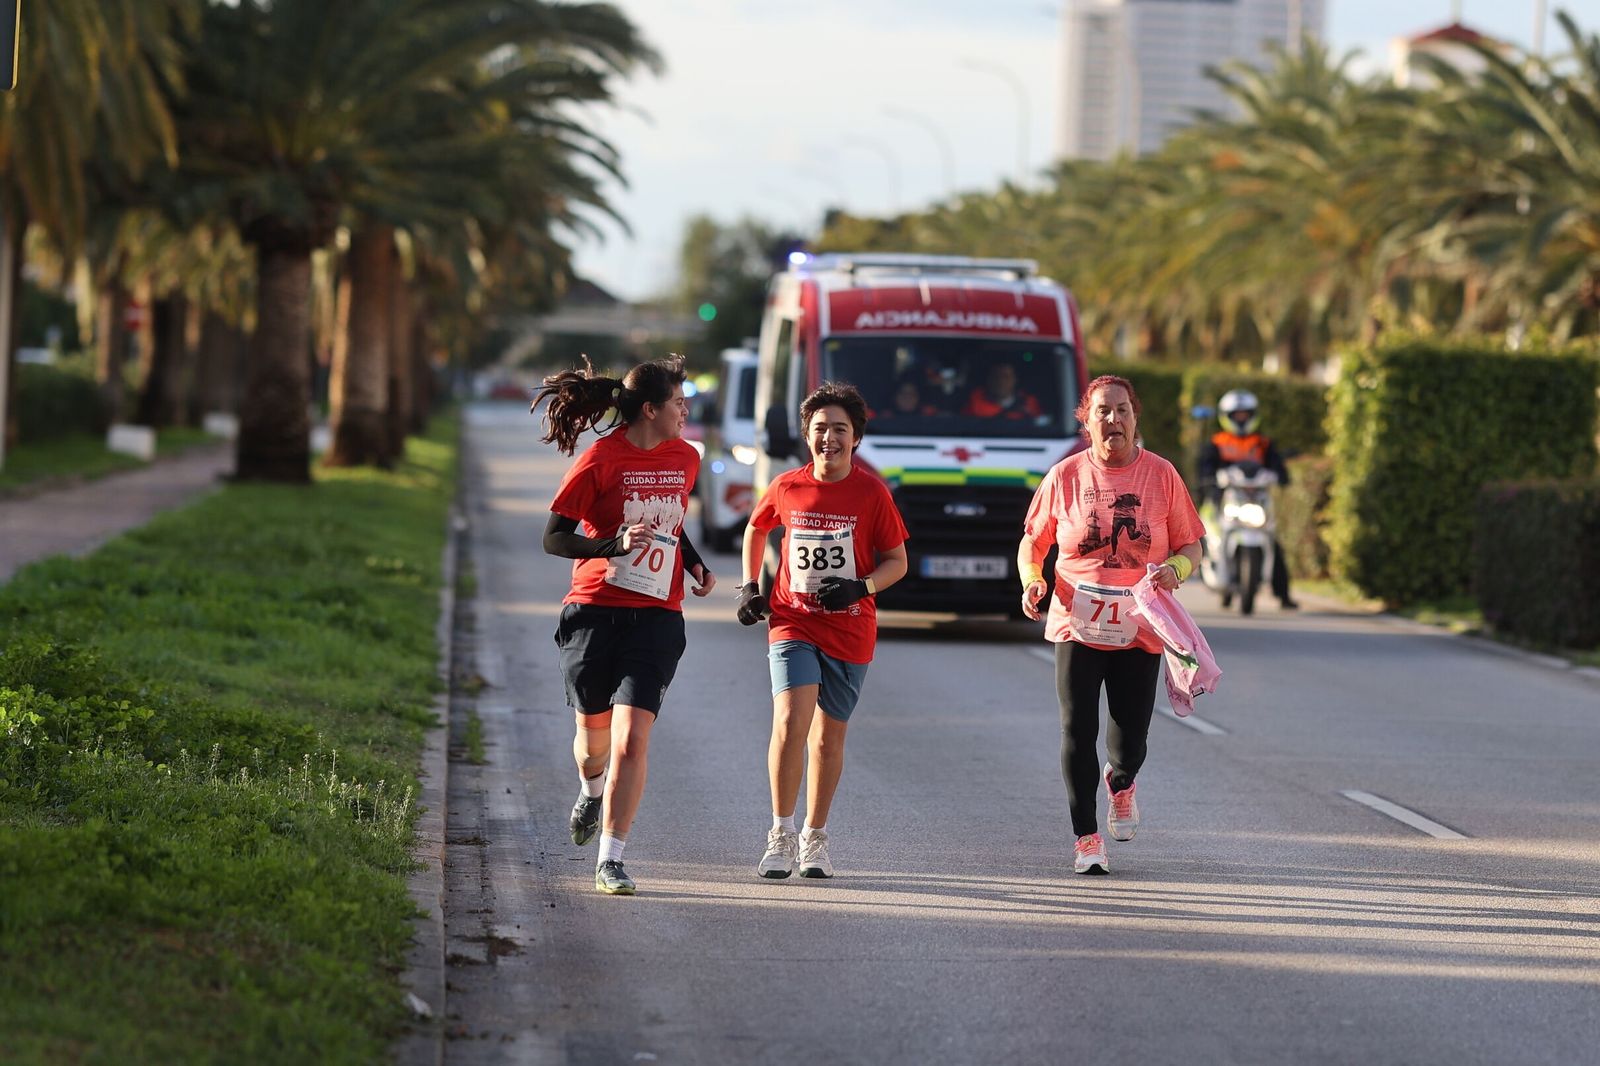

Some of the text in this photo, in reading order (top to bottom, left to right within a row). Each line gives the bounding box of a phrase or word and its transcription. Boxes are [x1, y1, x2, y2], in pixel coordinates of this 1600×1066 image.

[623, 475, 685, 485] CIUDAD JARDÍN
[790, 516, 856, 529] CIUDAD JARDÍN
[798, 511, 825, 519] CARRERA
[825, 513, 849, 521] URBANA
[631, 545, 664, 573] 70
[797, 545, 846, 571] 383
[1090, 599, 1121, 625] 71
